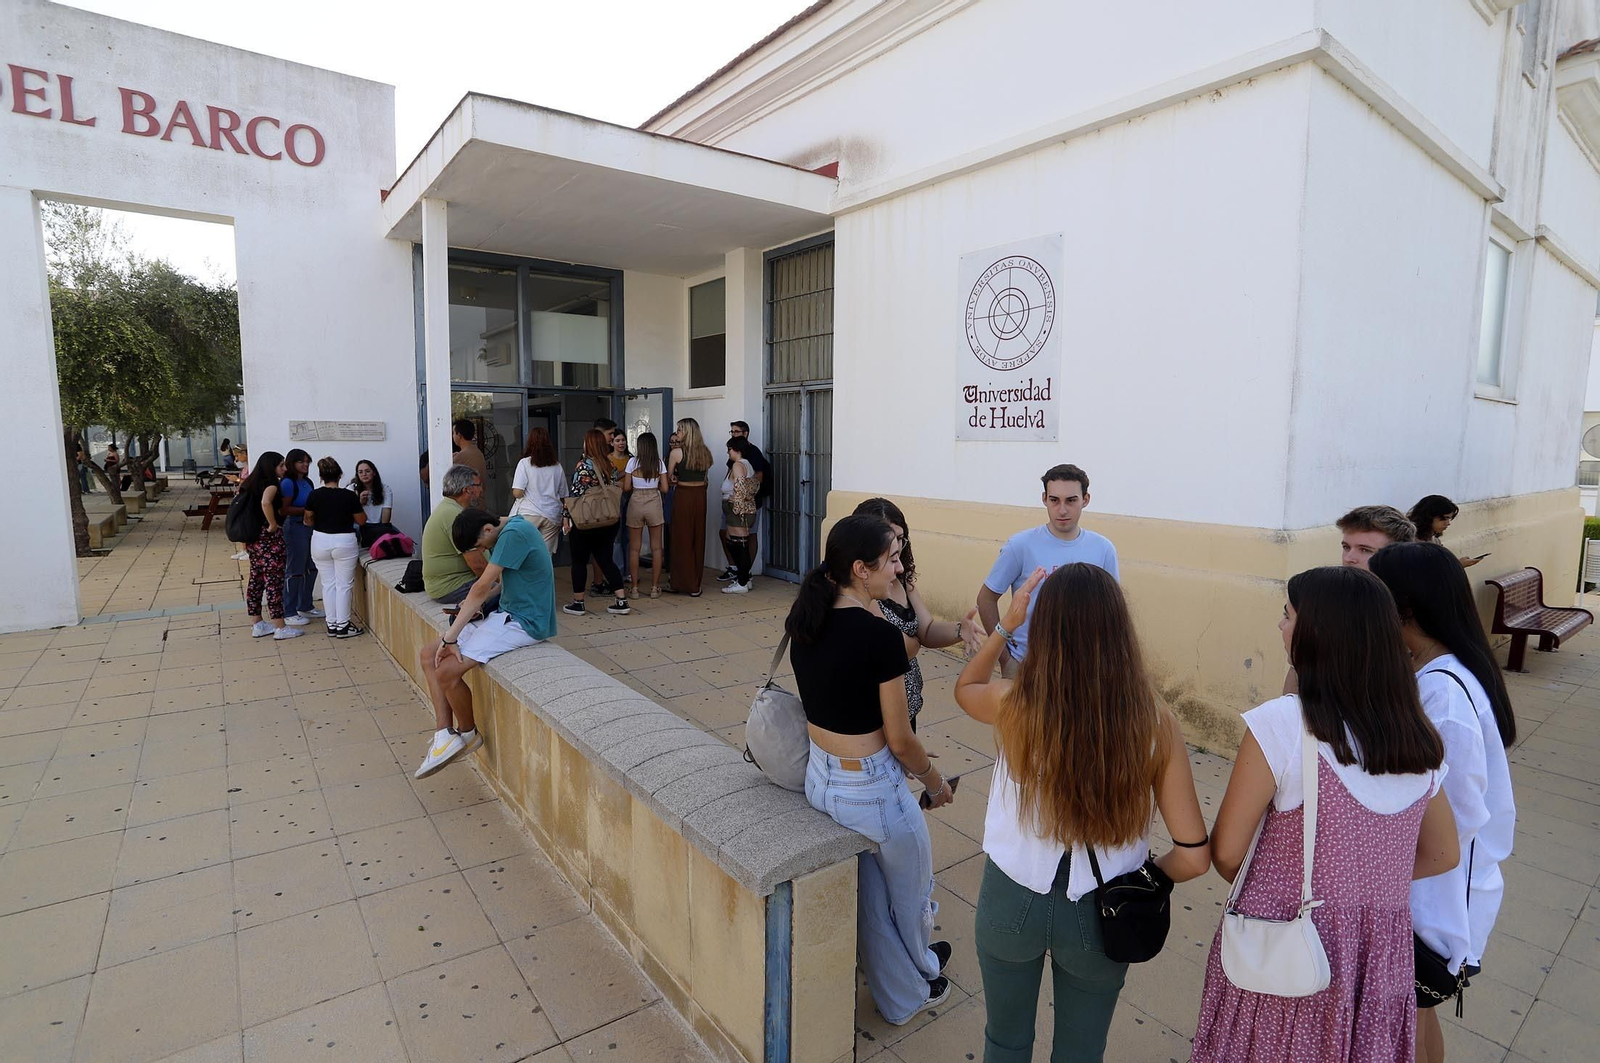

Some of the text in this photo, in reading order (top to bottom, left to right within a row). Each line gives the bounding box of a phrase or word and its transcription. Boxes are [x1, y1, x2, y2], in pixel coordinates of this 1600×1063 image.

[0, 63, 326, 167] EL BARCO
[967, 259, 1014, 330] VNIVERSITAS
[1001, 339, 1042, 369] SAPERE
[963, 377, 1051, 403] Universidad
[968, 406, 1045, 429] de Huelva
